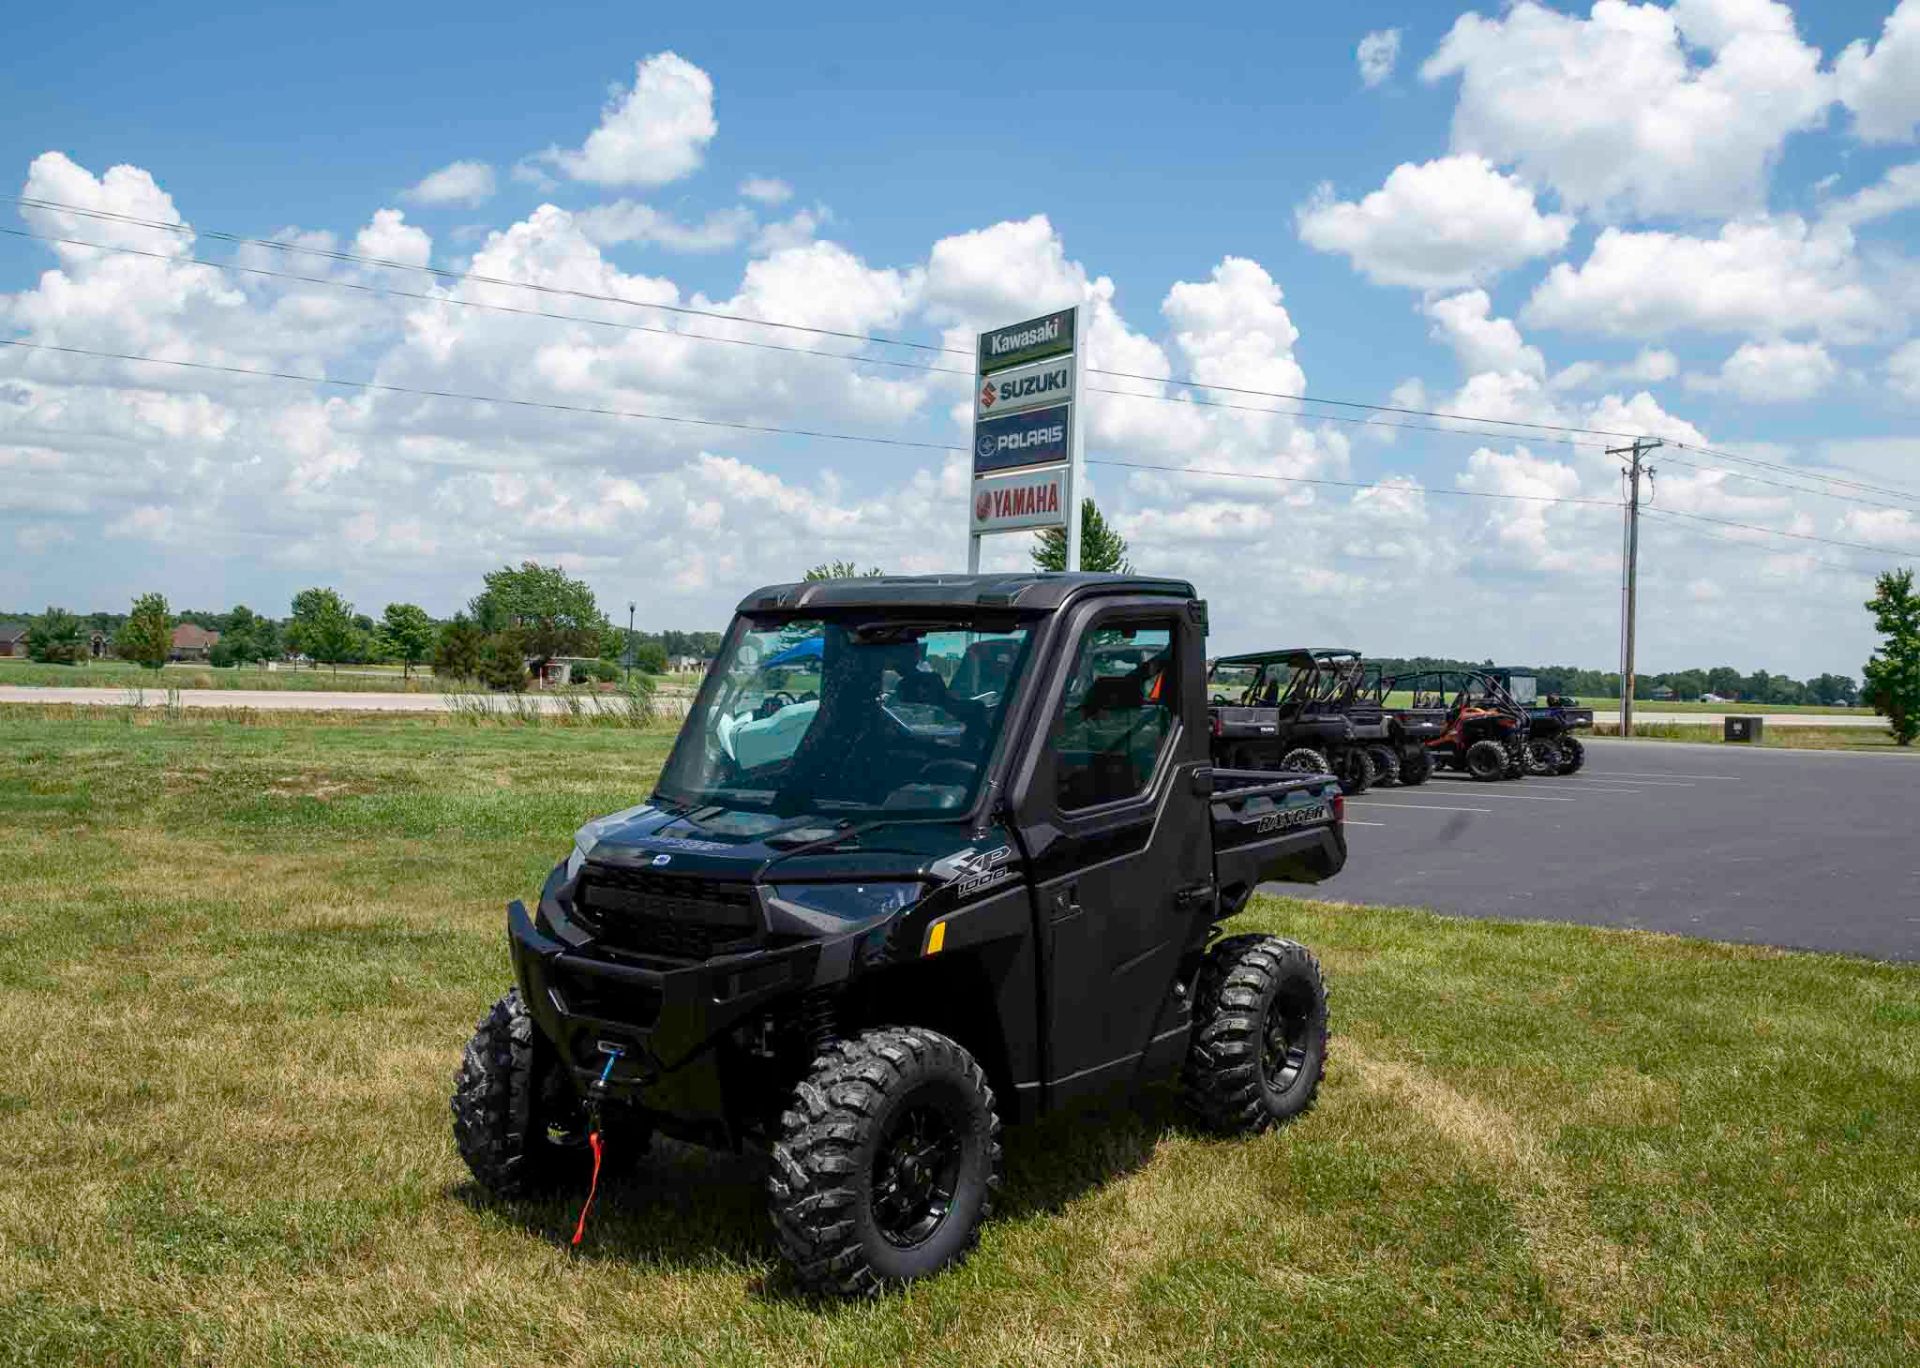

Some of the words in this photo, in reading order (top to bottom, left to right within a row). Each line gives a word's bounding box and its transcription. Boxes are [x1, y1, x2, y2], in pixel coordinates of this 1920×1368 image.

[991, 318, 1059, 355] Kawasaki
[1000, 369, 1067, 400] SUZUKI
[998, 426, 1063, 450] POLARIS
[994, 484, 1058, 517] YAMAHA
[1257, 805, 1324, 833] RANGER
[946, 846, 1011, 886] XP
[958, 867, 1007, 898] 1000
